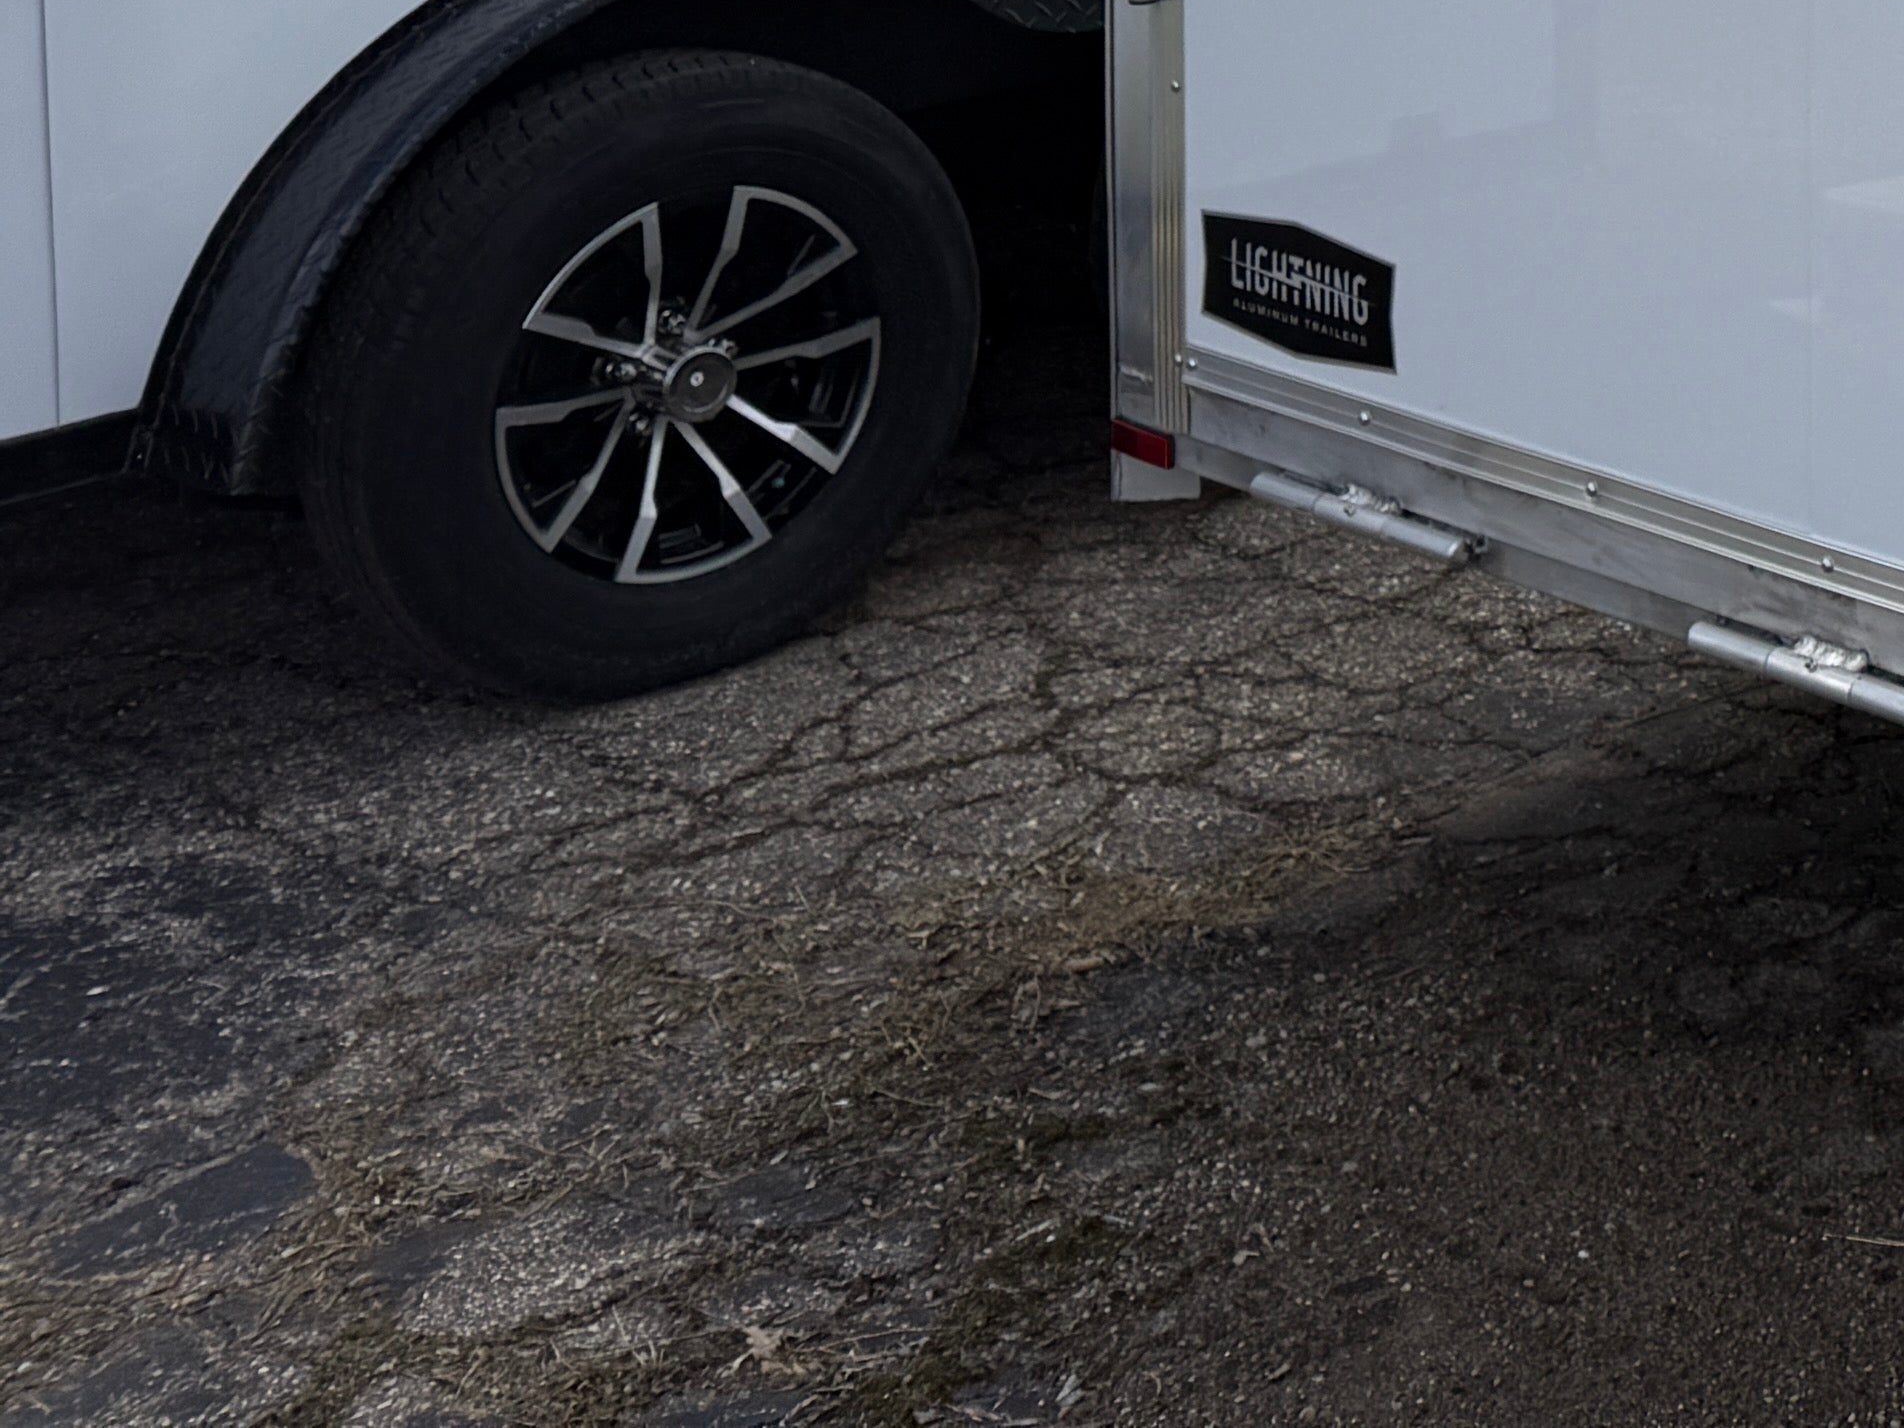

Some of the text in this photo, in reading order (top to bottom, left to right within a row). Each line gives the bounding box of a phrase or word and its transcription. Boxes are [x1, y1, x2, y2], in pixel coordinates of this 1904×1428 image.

[1230, 237, 1369, 326] LIGHTNING
[1233, 298, 1368, 347] ALUMINUM TRAILERS
